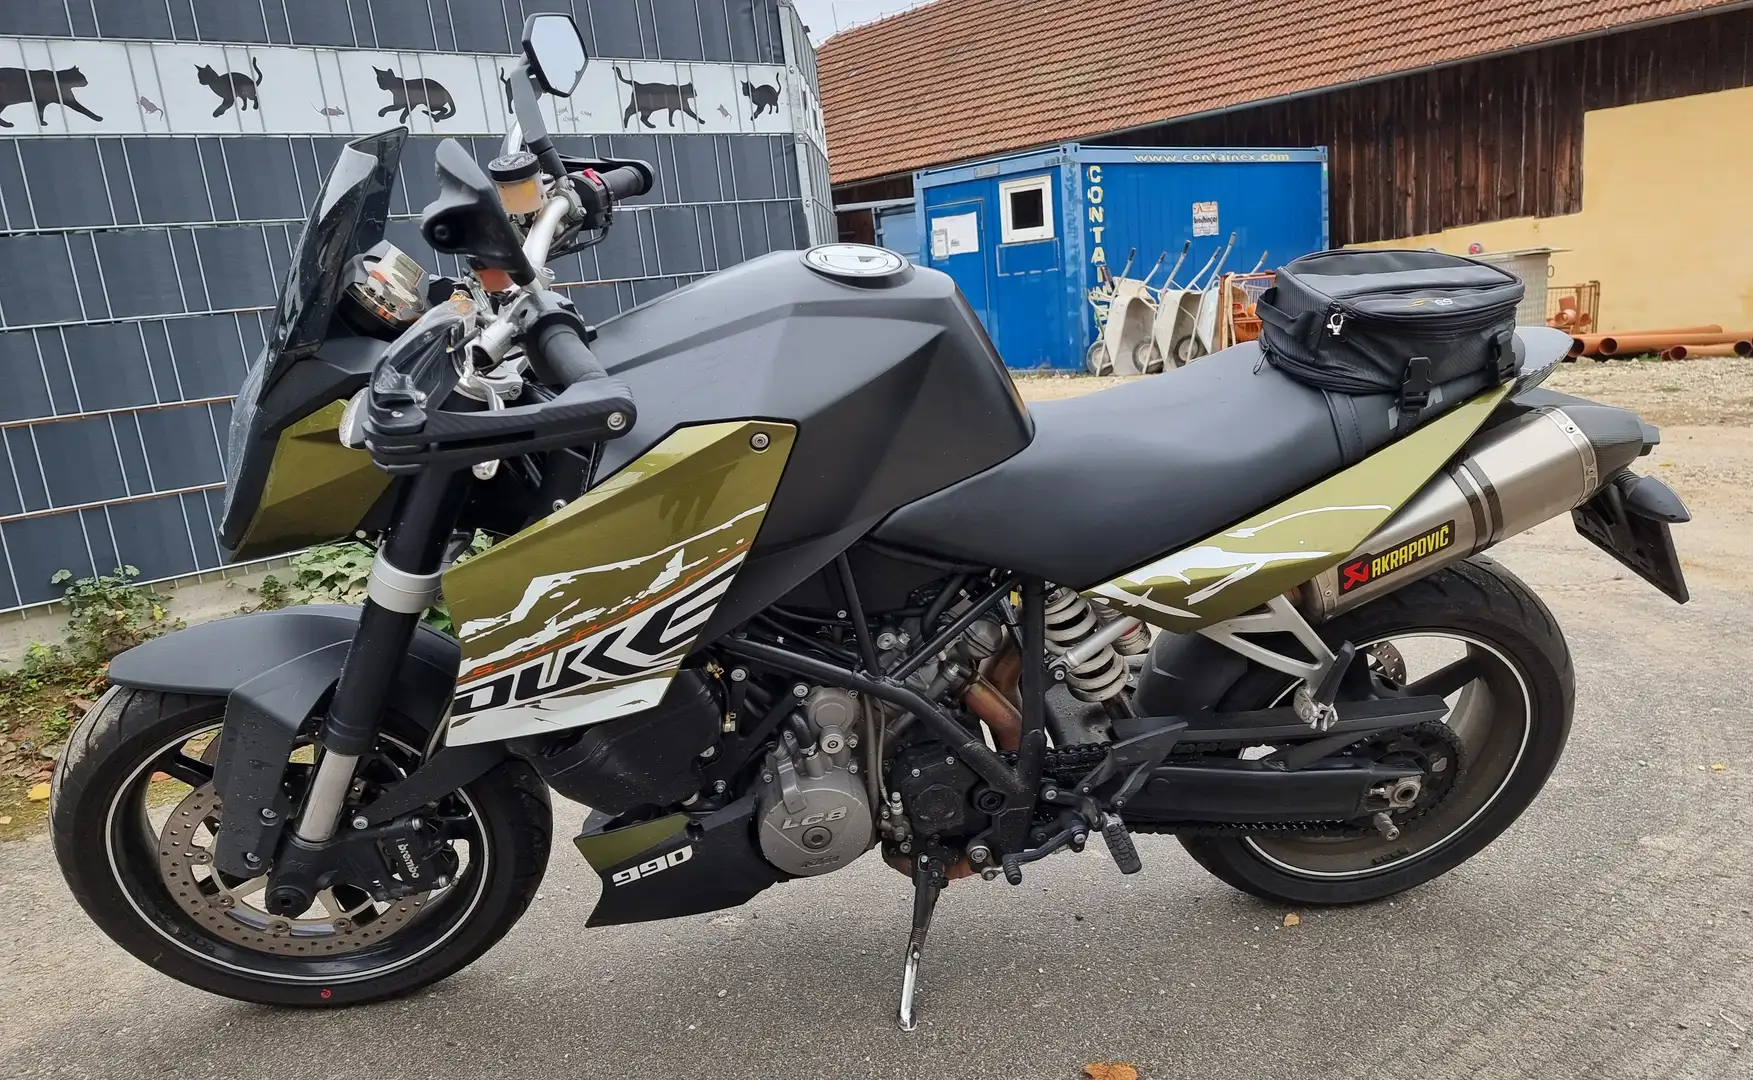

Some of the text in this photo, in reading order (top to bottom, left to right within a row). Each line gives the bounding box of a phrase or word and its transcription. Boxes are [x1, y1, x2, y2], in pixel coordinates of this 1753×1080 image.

[1133, 151, 1290, 163] www.containex.com
[449, 551, 749, 716] DUKE
[781, 806, 848, 830] LC8
[397, 843, 420, 879] brembo
[612, 844, 693, 887] 990
